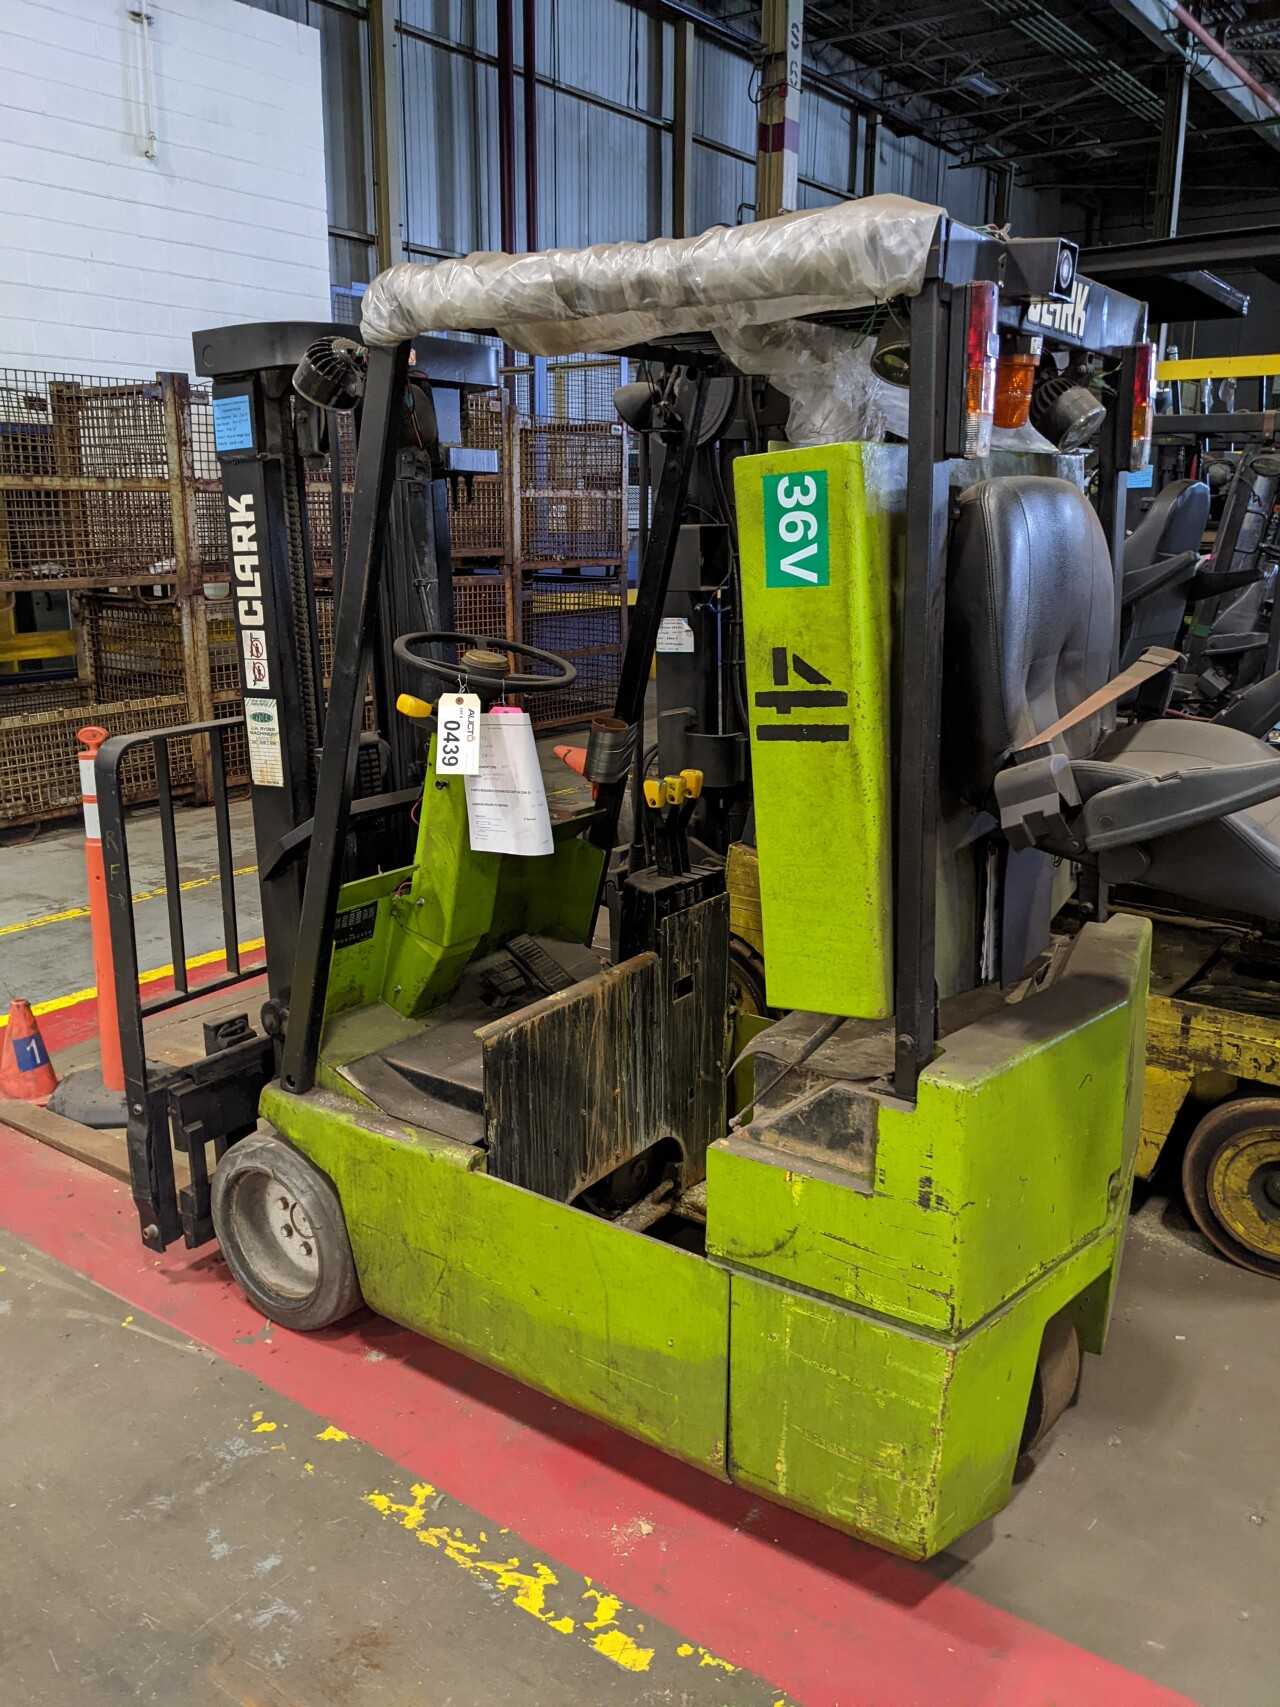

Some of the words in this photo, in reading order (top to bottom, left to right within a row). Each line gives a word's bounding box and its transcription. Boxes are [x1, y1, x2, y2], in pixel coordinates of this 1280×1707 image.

[228, 494, 264, 626] CLARK
[777, 475, 818, 584] 36V
[442, 720, 461, 767] 0439
[26, 1039, 40, 1064] 1
